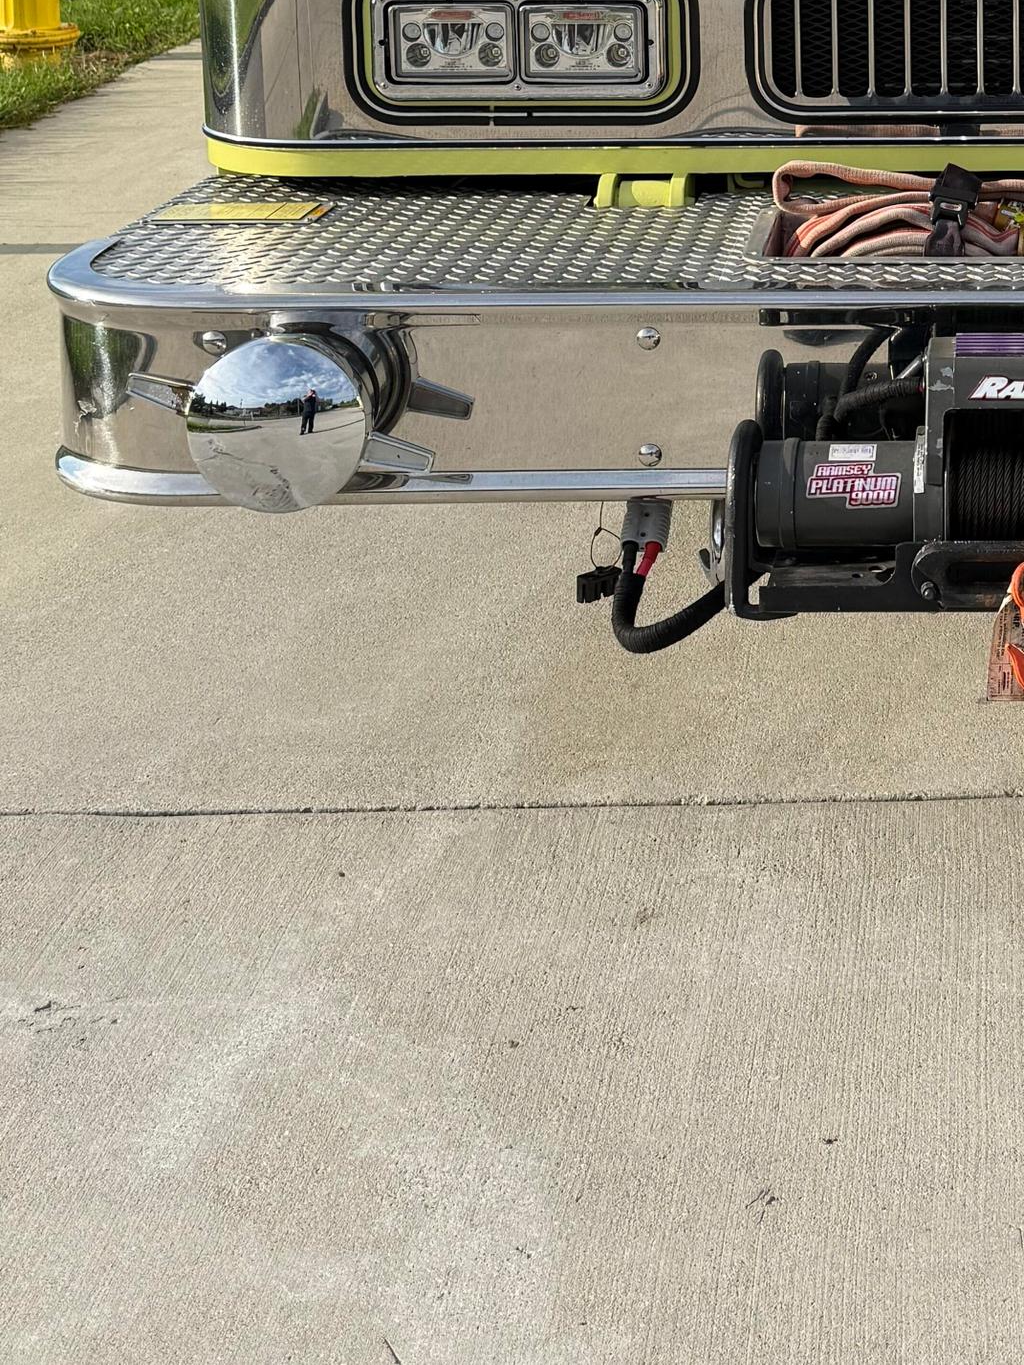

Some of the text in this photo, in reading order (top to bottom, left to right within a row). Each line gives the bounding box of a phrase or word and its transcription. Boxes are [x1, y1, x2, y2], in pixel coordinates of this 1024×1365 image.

[816, 464, 872, 477] RAMSEY
[810, 476, 898, 494] PLATINUM
[850, 490, 895, 505] 9000
